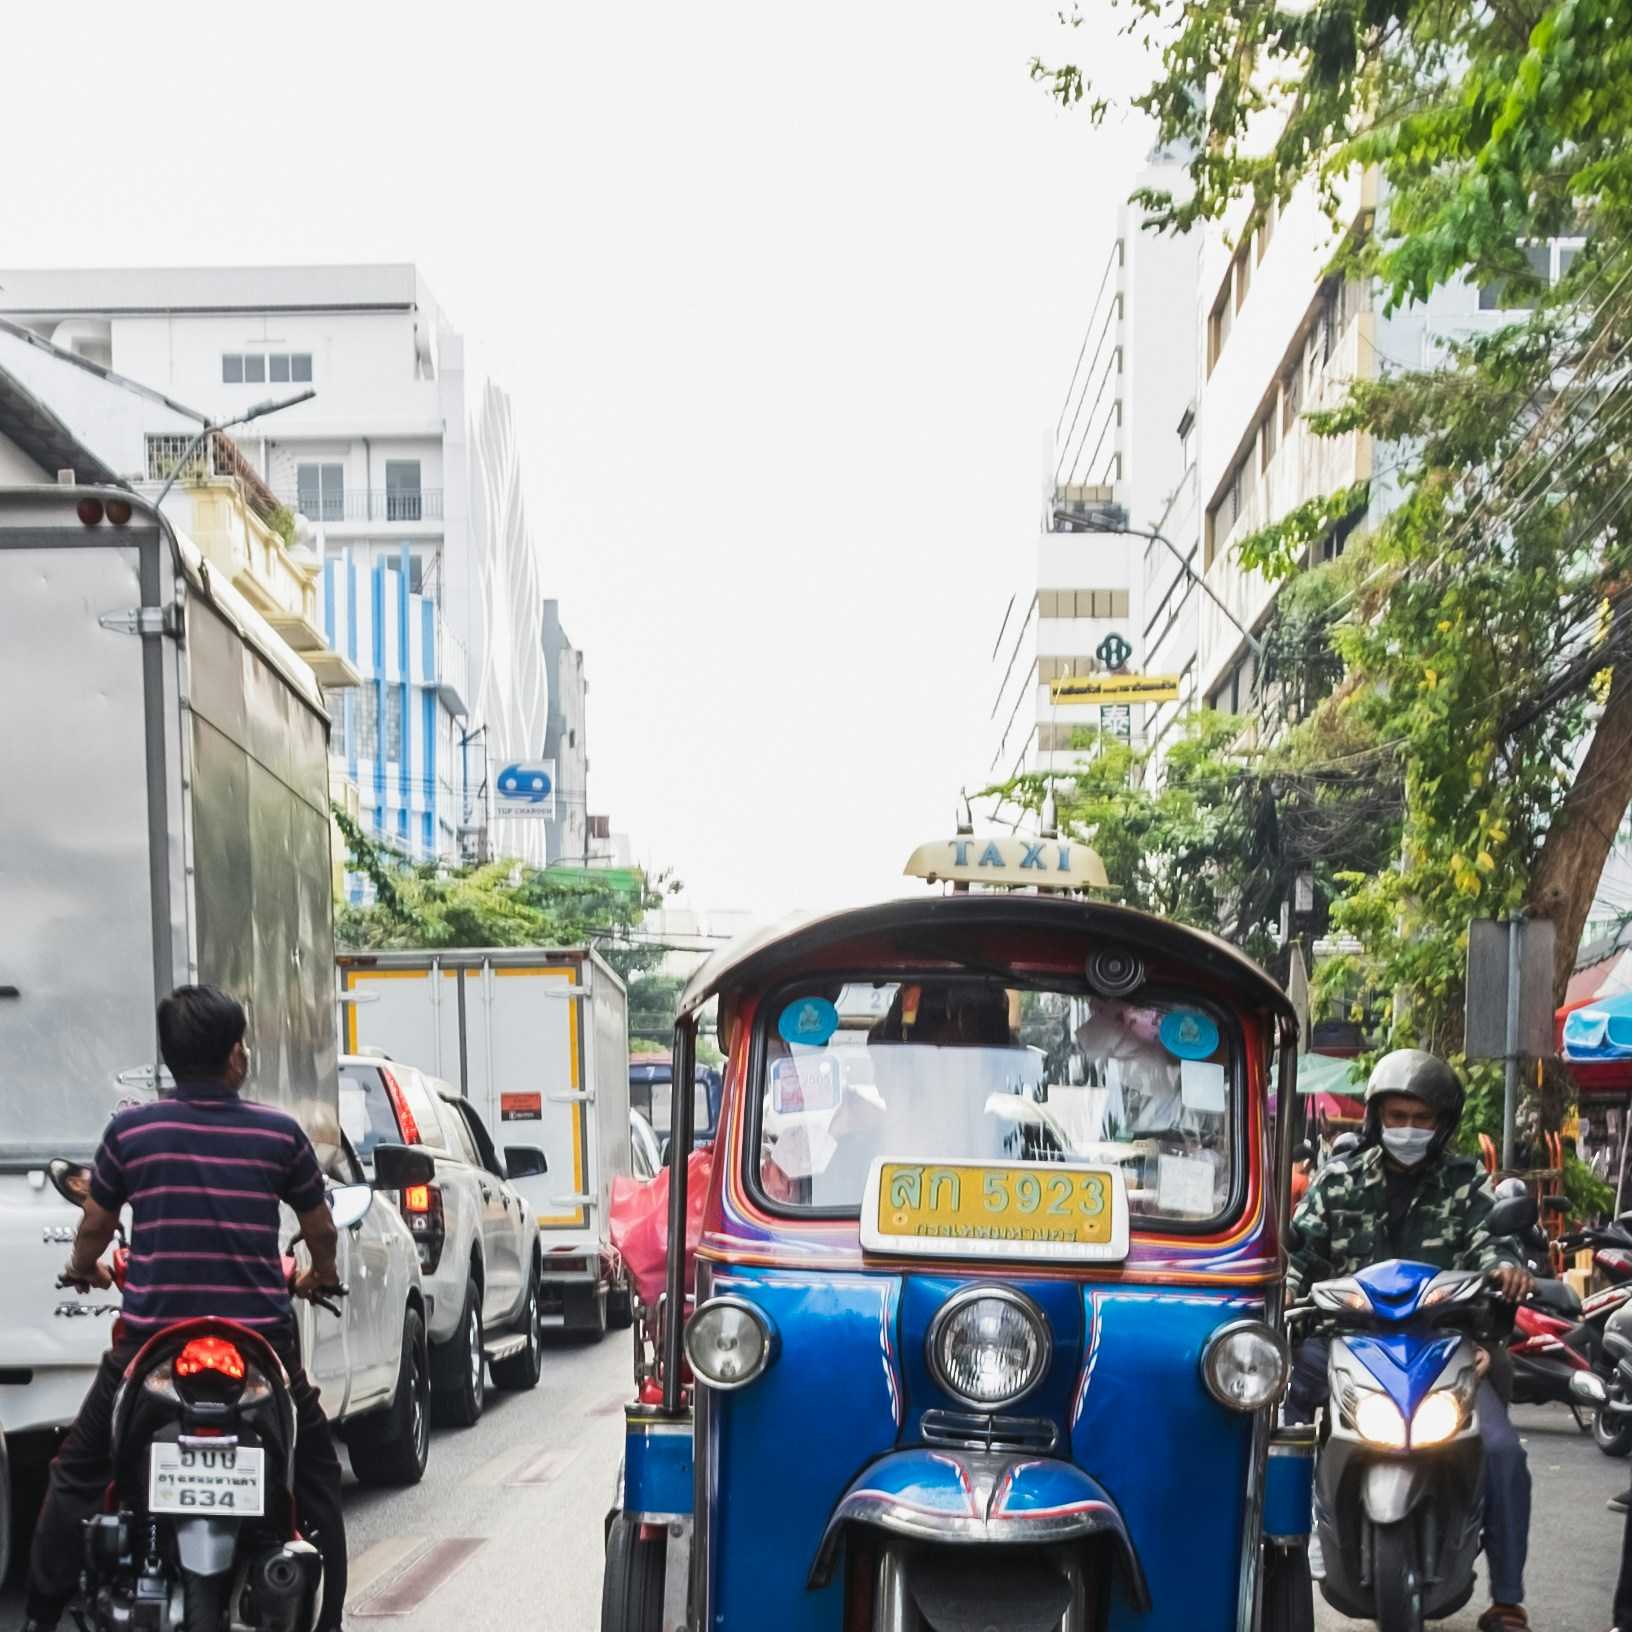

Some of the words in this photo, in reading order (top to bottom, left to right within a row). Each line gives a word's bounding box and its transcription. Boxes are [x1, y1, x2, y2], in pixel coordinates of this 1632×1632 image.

[948, 839, 1071, 872] TAXI
[889, 1166, 961, 1213] สก
[983, 1170, 1106, 1217] 5923
[179, 1489, 236, 1508] 634
